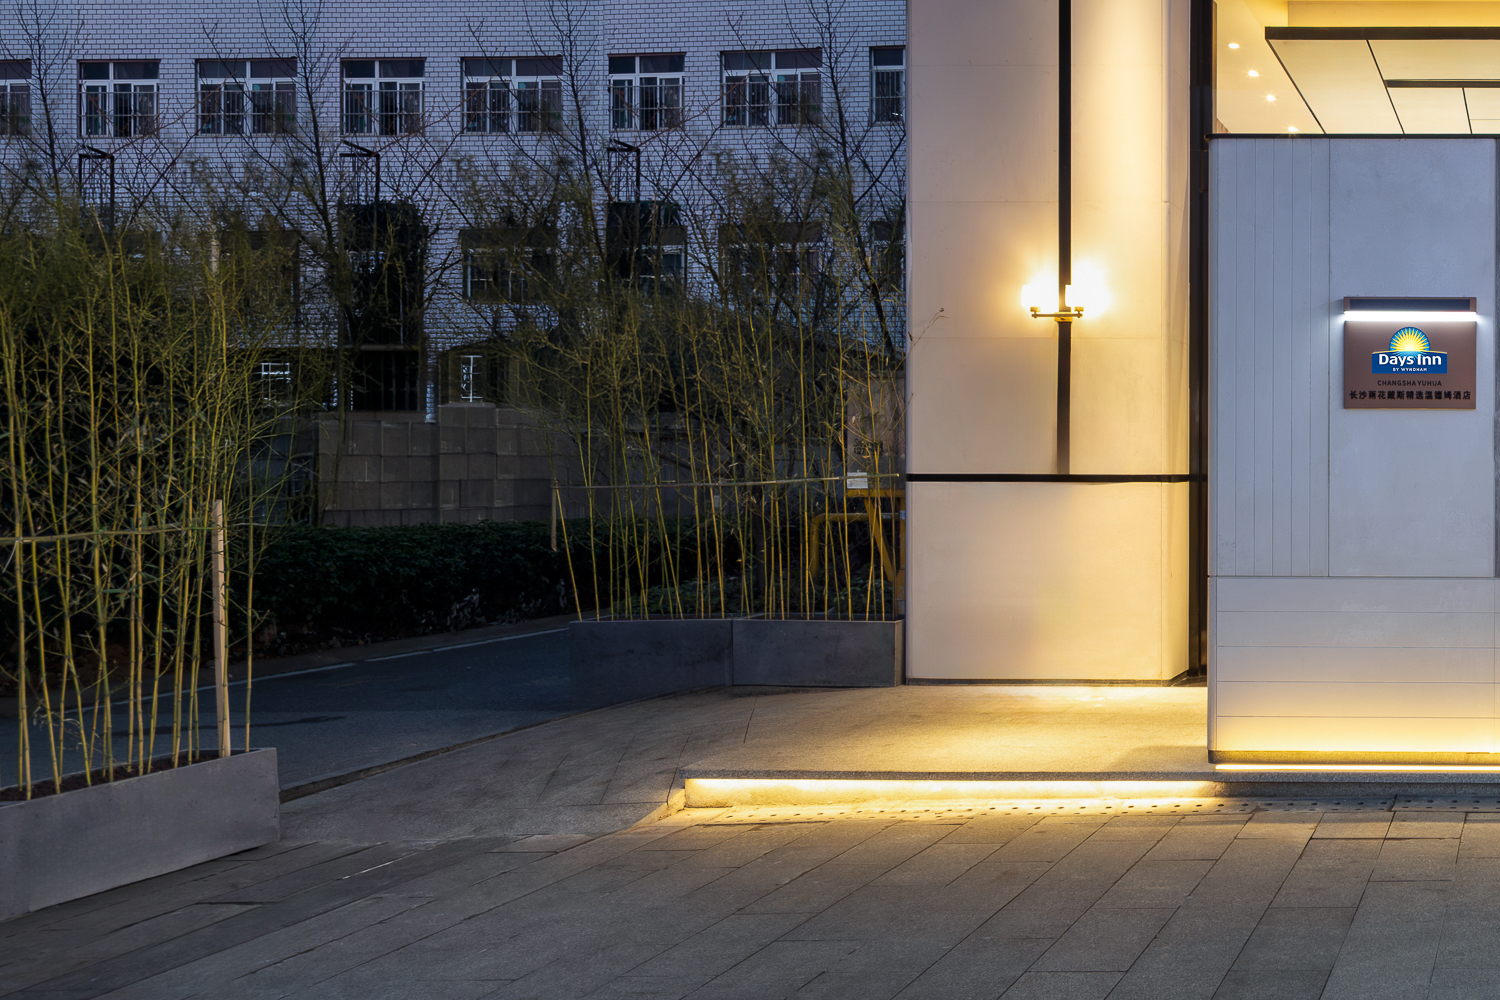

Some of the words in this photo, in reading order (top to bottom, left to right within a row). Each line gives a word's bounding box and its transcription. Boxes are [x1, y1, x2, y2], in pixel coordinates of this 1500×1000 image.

[1379, 354, 1414, 366] Days
[1417, 354, 1442, 366] Inn
[1349, 390, 1472, 400] 长沙雨花戴斯精选温德姆酒店
